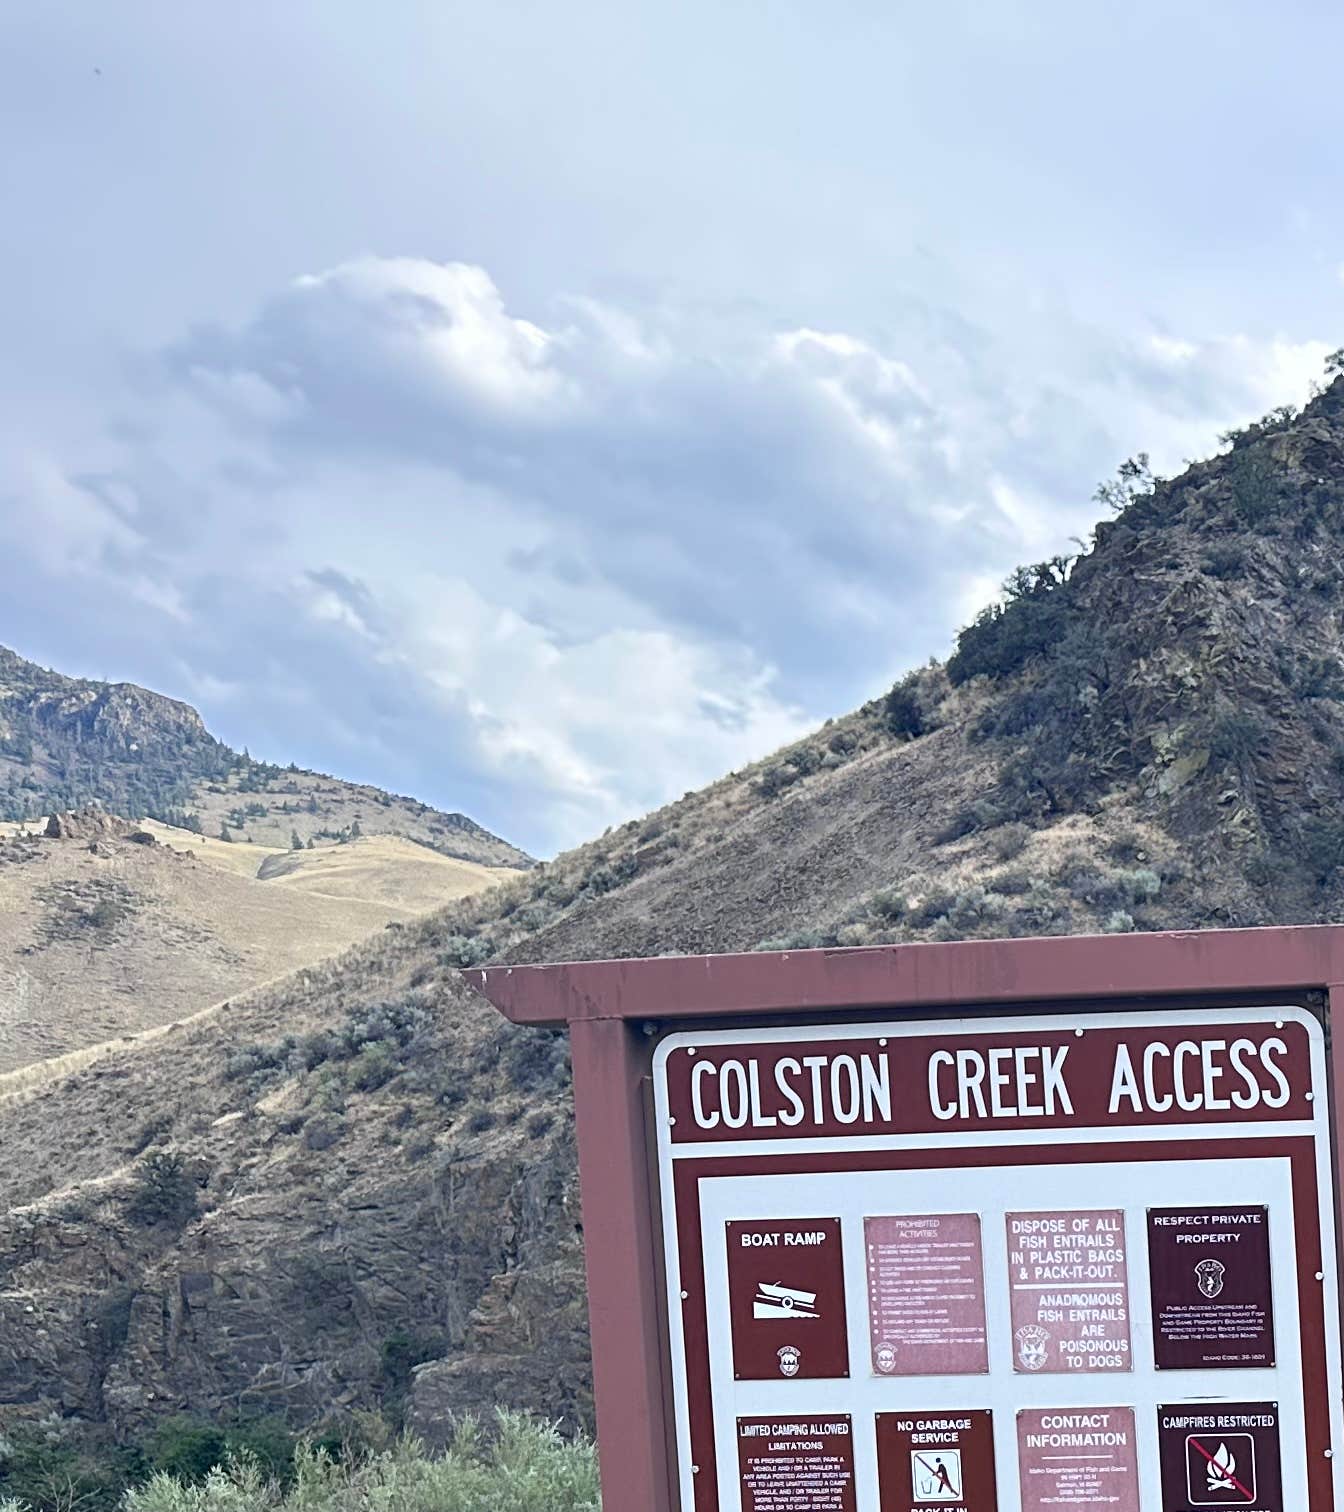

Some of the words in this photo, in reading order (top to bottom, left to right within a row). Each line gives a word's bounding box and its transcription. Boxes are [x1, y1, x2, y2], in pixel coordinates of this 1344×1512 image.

[691, 1052, 892, 1130] COLSTON
[928, 1046, 1075, 1118] CREEK
[1109, 1038, 1292, 1114] ACCESS
[1012, 1220, 1066, 1234] DISPOSE
[1072, 1219, 1090, 1232] OF
[1096, 1219, 1120, 1231] ALL
[1154, 1216, 1209, 1225] RESPECT
[1212, 1215, 1261, 1224] PRIVATE
[742, 1234, 780, 1246] BOAT
[784, 1232, 826, 1245] RAMP
[1020, 1236, 1047, 1248] FISH
[1054, 1234, 1114, 1248] ENTRAILS
[1177, 1234, 1240, 1243] PROPERTY
[1012, 1252, 1024, 1264] IN
[1030, 1250, 1082, 1264] PLASTIC
[1088, 1249, 1124, 1262] BAGS
[1020, 1268, 1028, 1280] &
[1035, 1265, 1117, 1279] PACK-IT-OUT.
[1039, 1293, 1123, 1306] ANADROMOUS
[1038, 1310, 1063, 1322] FISH
[1070, 1309, 1126, 1322] ENTRAILS
[1081, 1325, 1105, 1337] ARE
[1060, 1339, 1128, 1353] POISONOUS
[1066, 1356, 1083, 1368] TO
[1089, 1355, 1122, 1367] DOGS
[898, 1421, 914, 1431] NO
[916, 1419, 971, 1430] GARBAGE
[1042, 1415, 1110, 1429] CONTACT
[1163, 1416, 1215, 1428] CAMPFIRES
[1218, 1415, 1274, 1427] RESTRICTED
[740, 1425, 770, 1436] LIMITED
[772, 1424, 808, 1436] CAMPING
[810, 1424, 848, 1435] ALLOWED
[912, 1432, 959, 1443] SERVICE
[1027, 1433, 1126, 1447] INFORMATION
[769, 1442, 823, 1451] LIMITATIONS
